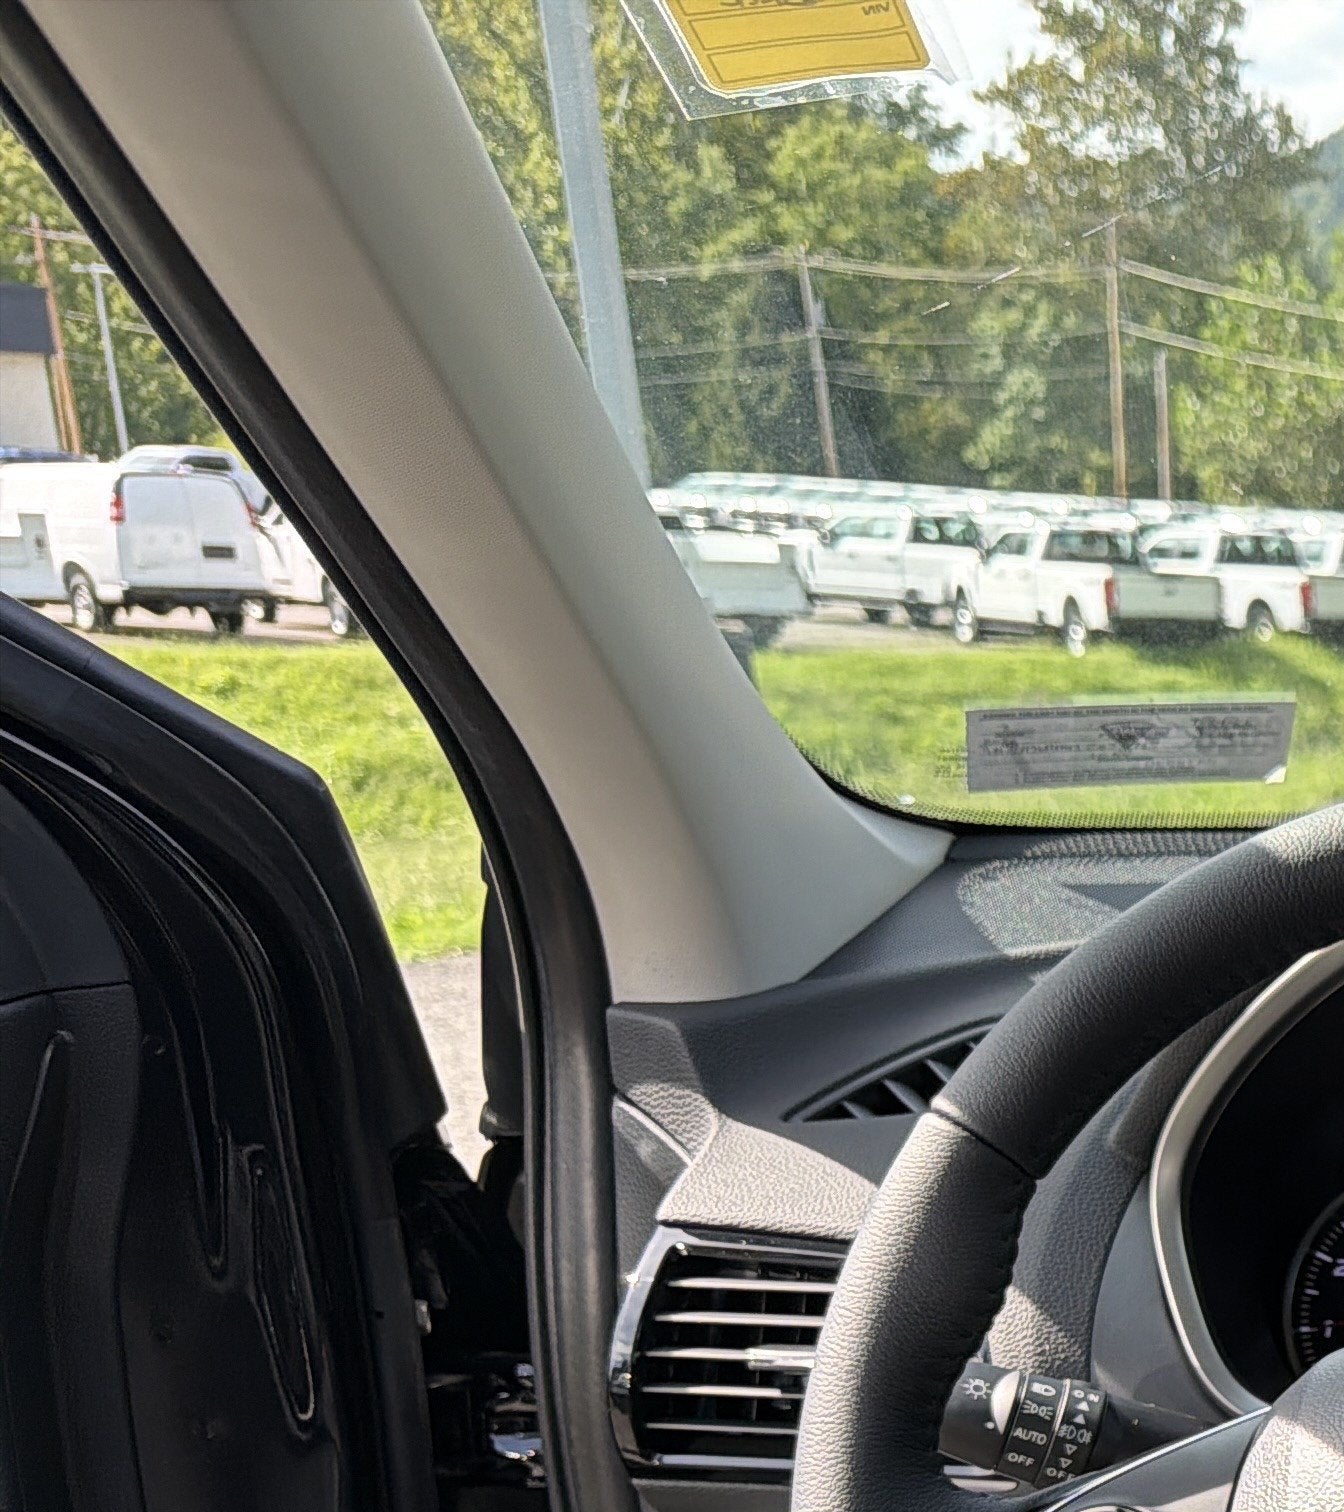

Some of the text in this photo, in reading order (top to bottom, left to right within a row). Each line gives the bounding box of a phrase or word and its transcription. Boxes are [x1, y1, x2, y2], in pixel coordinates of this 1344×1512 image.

[1072, 1390, 1099, 1402] ON
[1013, 1427, 1047, 1445] AUTO
[1007, 1453, 1035, 1466] OFF
